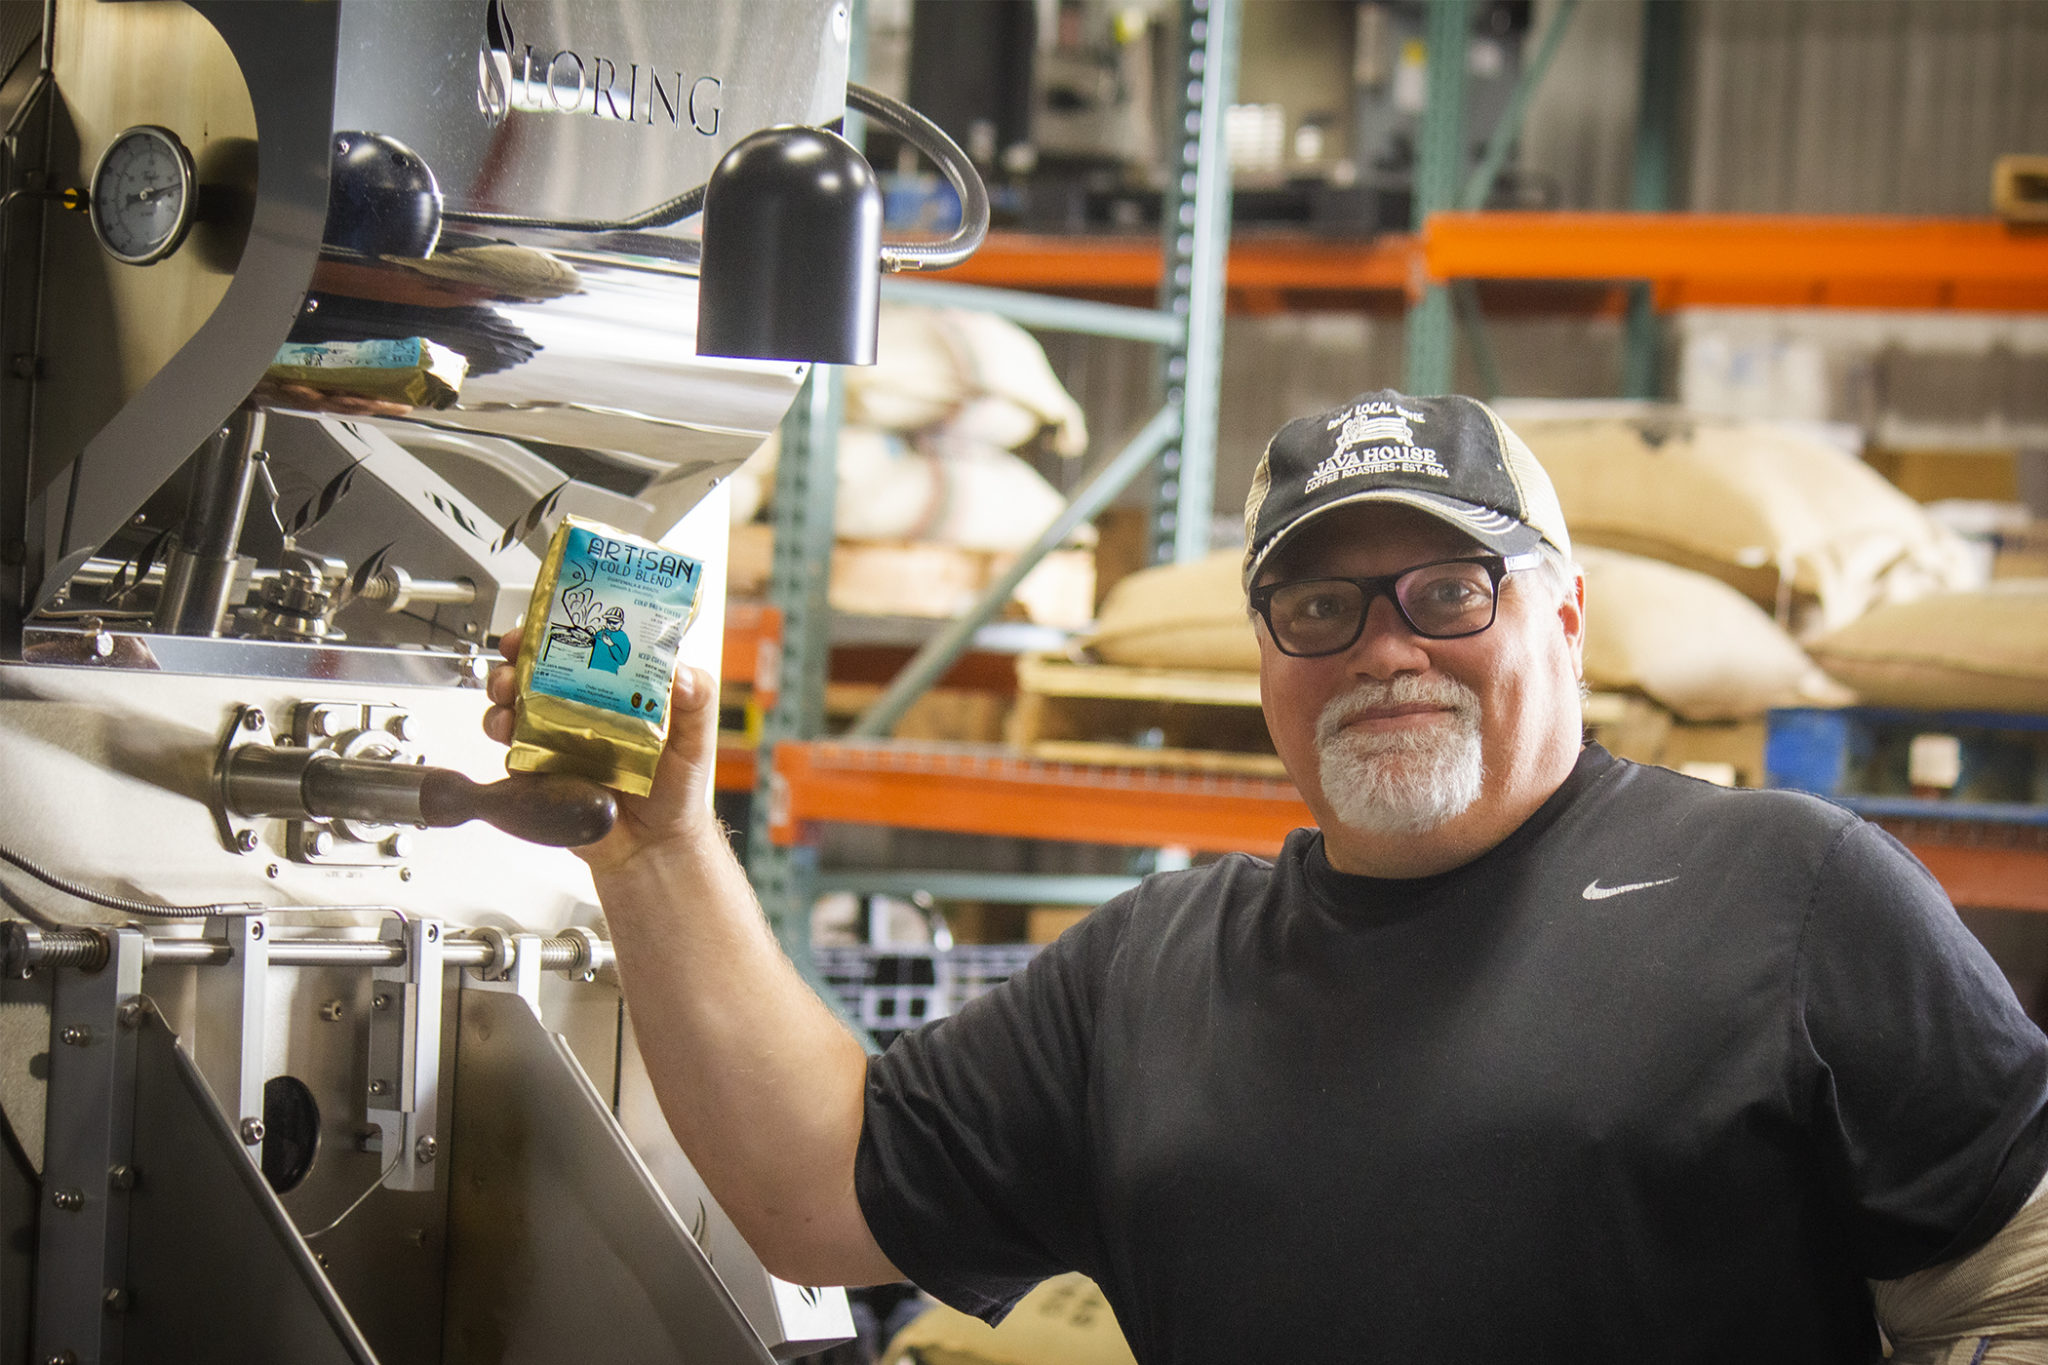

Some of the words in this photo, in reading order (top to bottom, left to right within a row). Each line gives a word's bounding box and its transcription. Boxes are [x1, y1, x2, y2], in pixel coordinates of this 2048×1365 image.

[523, 44, 722, 136] LORING
[1355, 402, 1394, 415] LOCAL
[1313, 451, 1360, 476] JAVA
[1363, 446, 1437, 463] HOUSE
[1304, 471, 1339, 494] COFFEE
[1341, 462, 1396, 479] ROASTERS
[1402, 463, 1425, 473] EST.
[600, 560, 631, 577] COLD
[635, 569, 673, 589] BLEND
